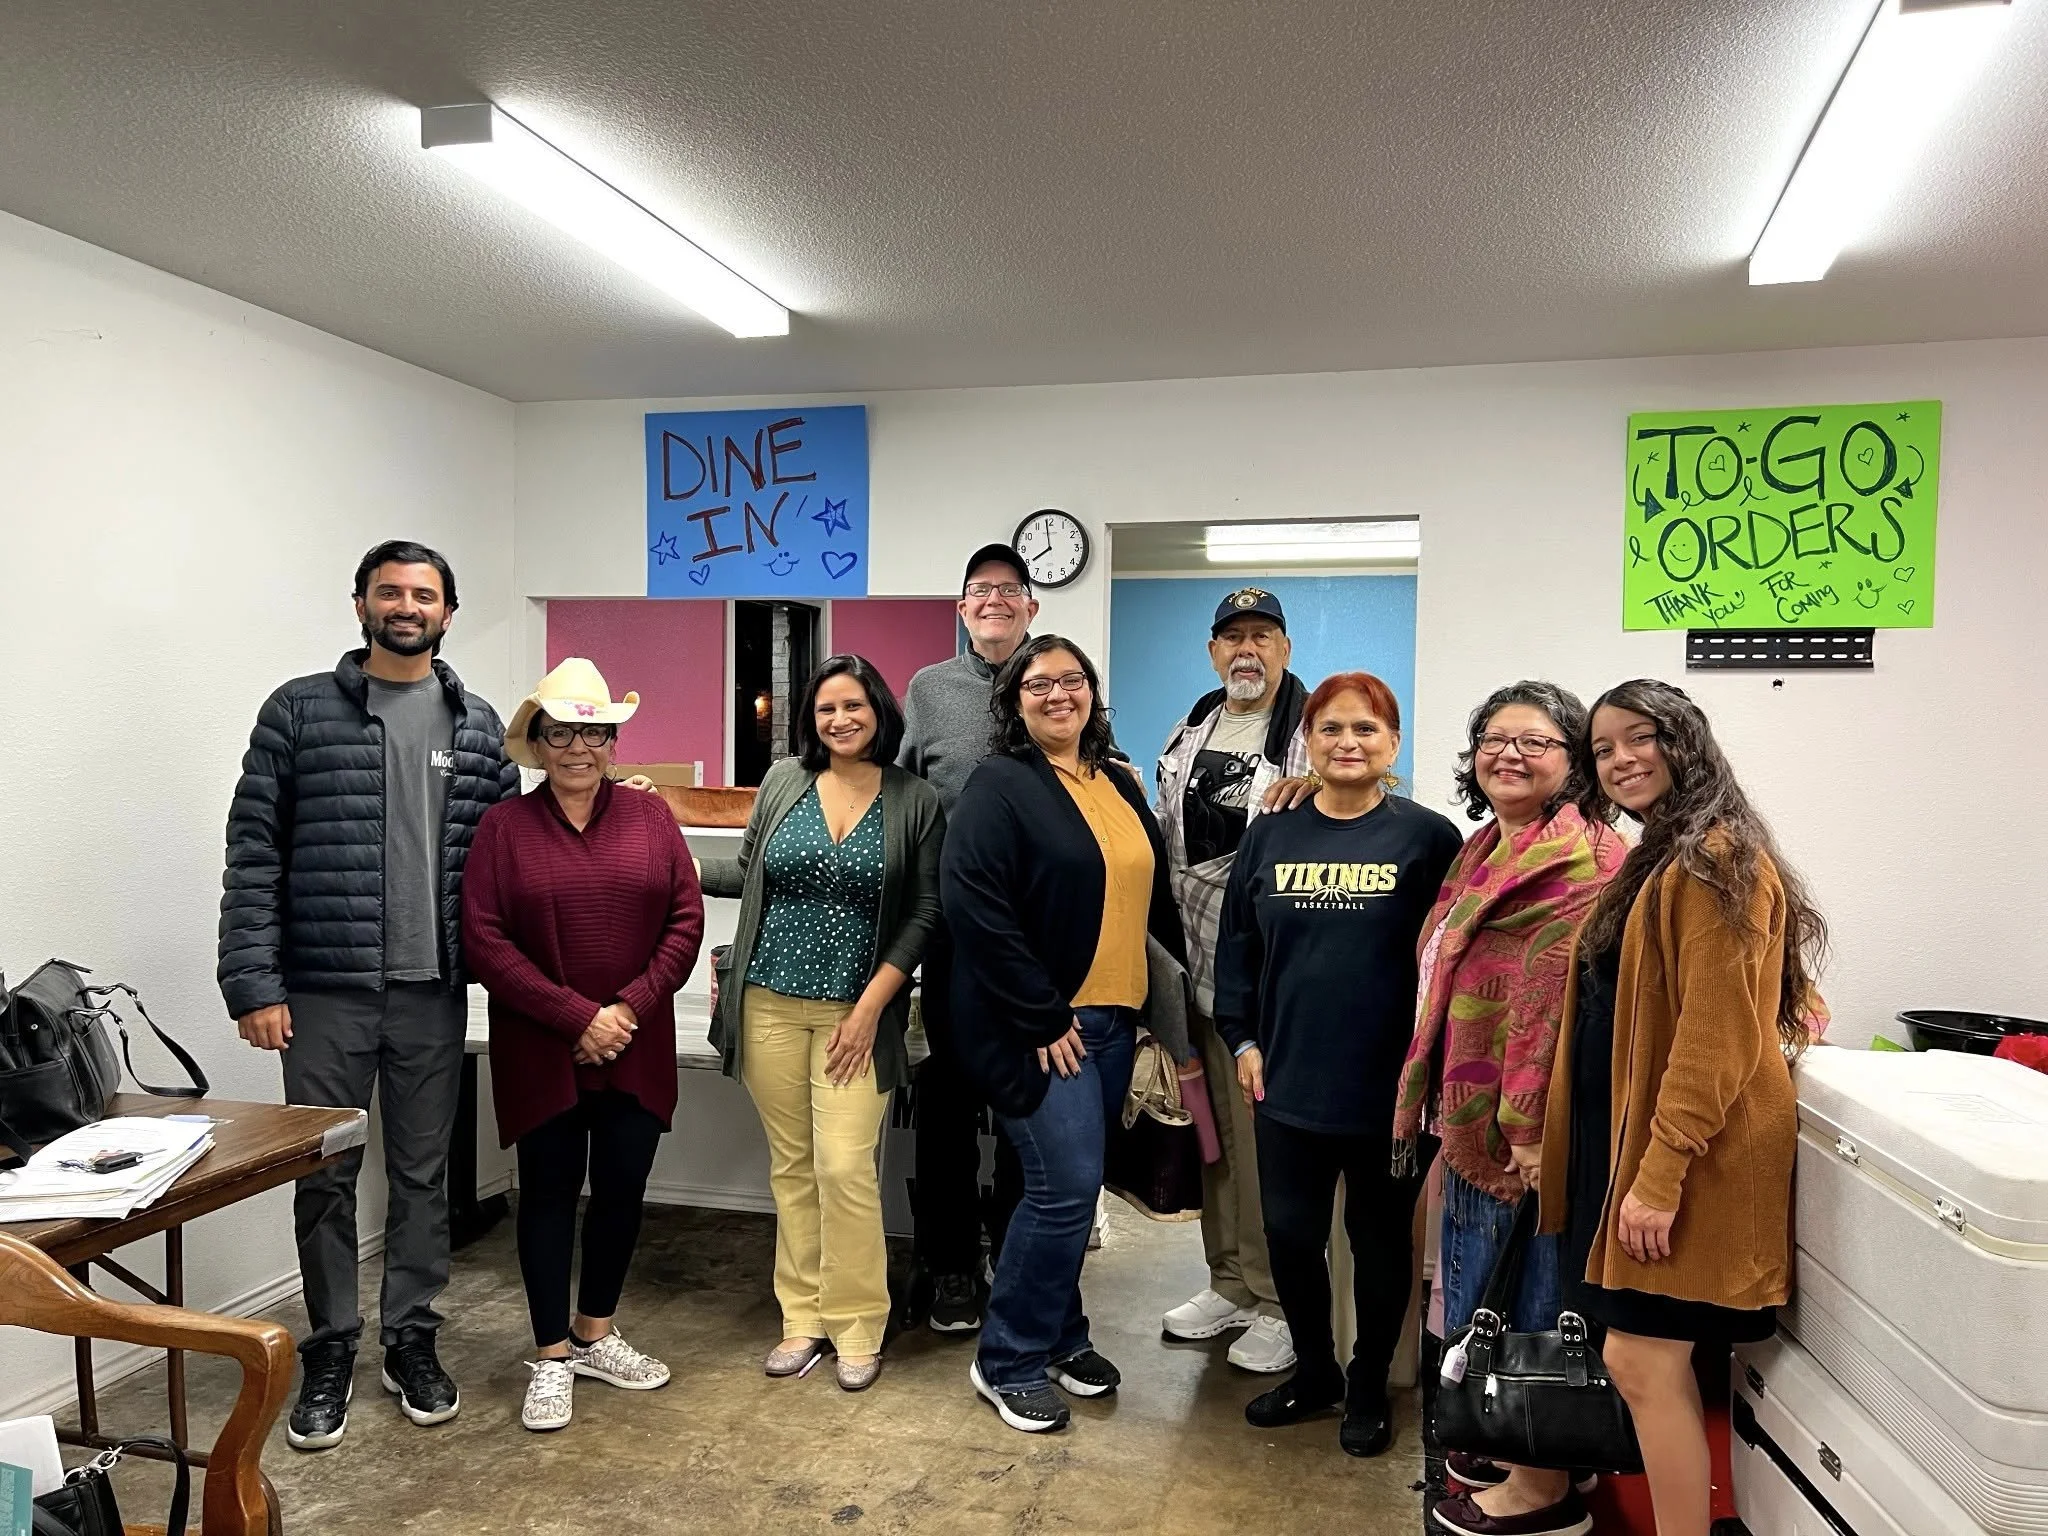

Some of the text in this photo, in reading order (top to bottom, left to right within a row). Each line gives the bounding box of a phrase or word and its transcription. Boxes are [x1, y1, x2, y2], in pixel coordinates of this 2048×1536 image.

[663, 417, 817, 501] DINE
[1637, 415, 1898, 501] TO-GO
[1074, 544, 1080, 552] 3
[1657, 497, 1906, 583] ORDERS
[1047, 571, 1053, 579] 6
[1643, 582, 1725, 625] THANK
[1274, 863, 1399, 892] VIKINGS
[1294, 901, 1365, 910] BASKETBALL
